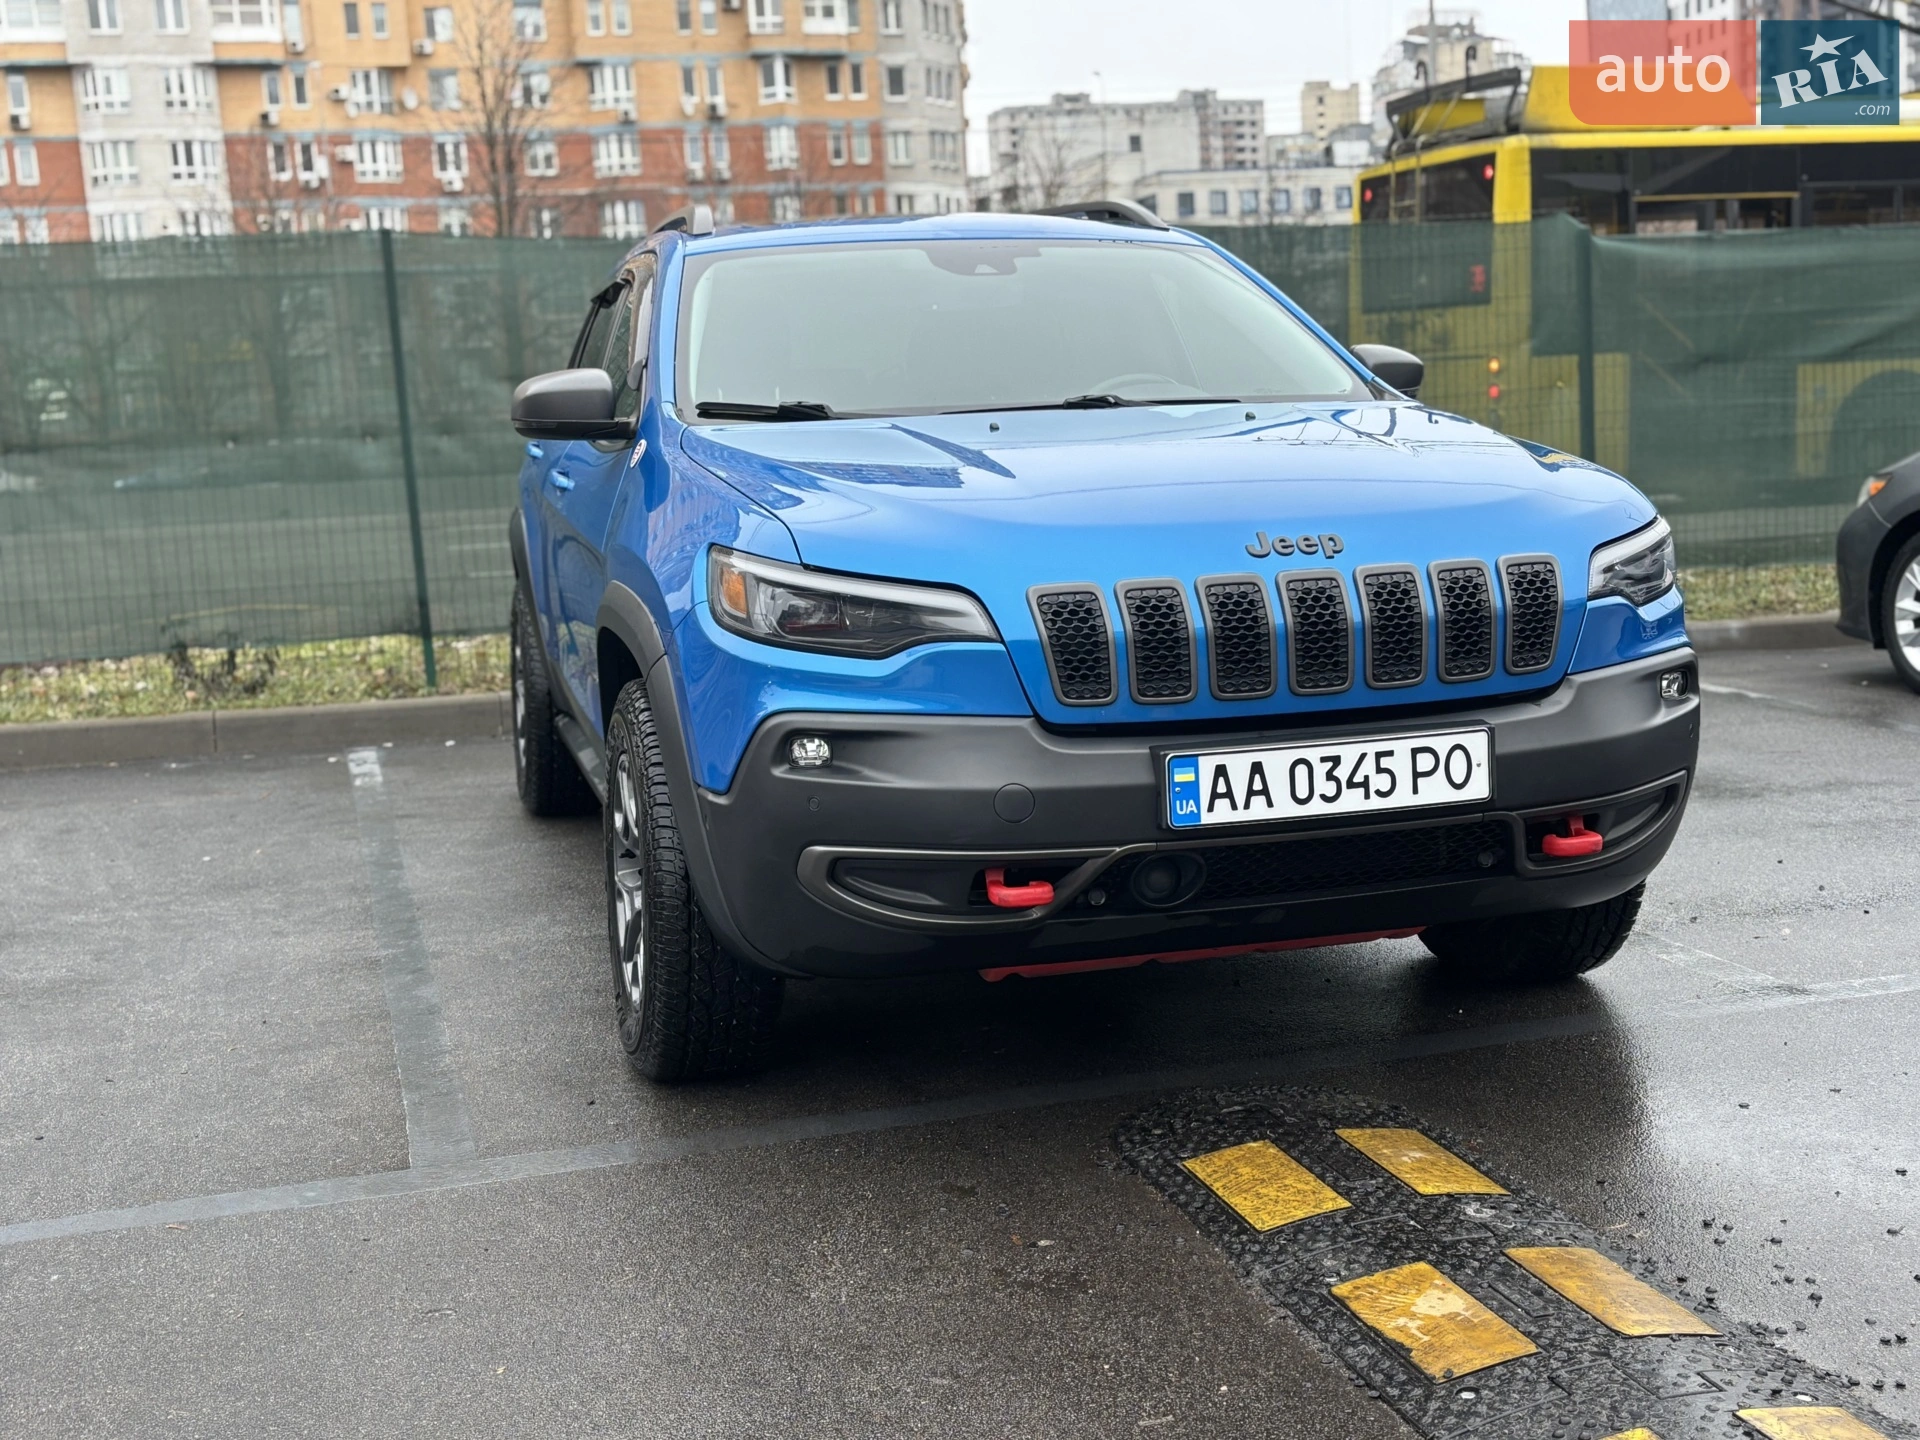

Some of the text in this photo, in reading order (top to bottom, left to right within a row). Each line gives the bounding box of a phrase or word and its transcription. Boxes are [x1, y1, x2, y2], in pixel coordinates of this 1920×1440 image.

[1245, 531, 1344, 559] Jeep
[1207, 743, 1473, 813] AA 0345 PO
[1176, 799, 1198, 815] UA
